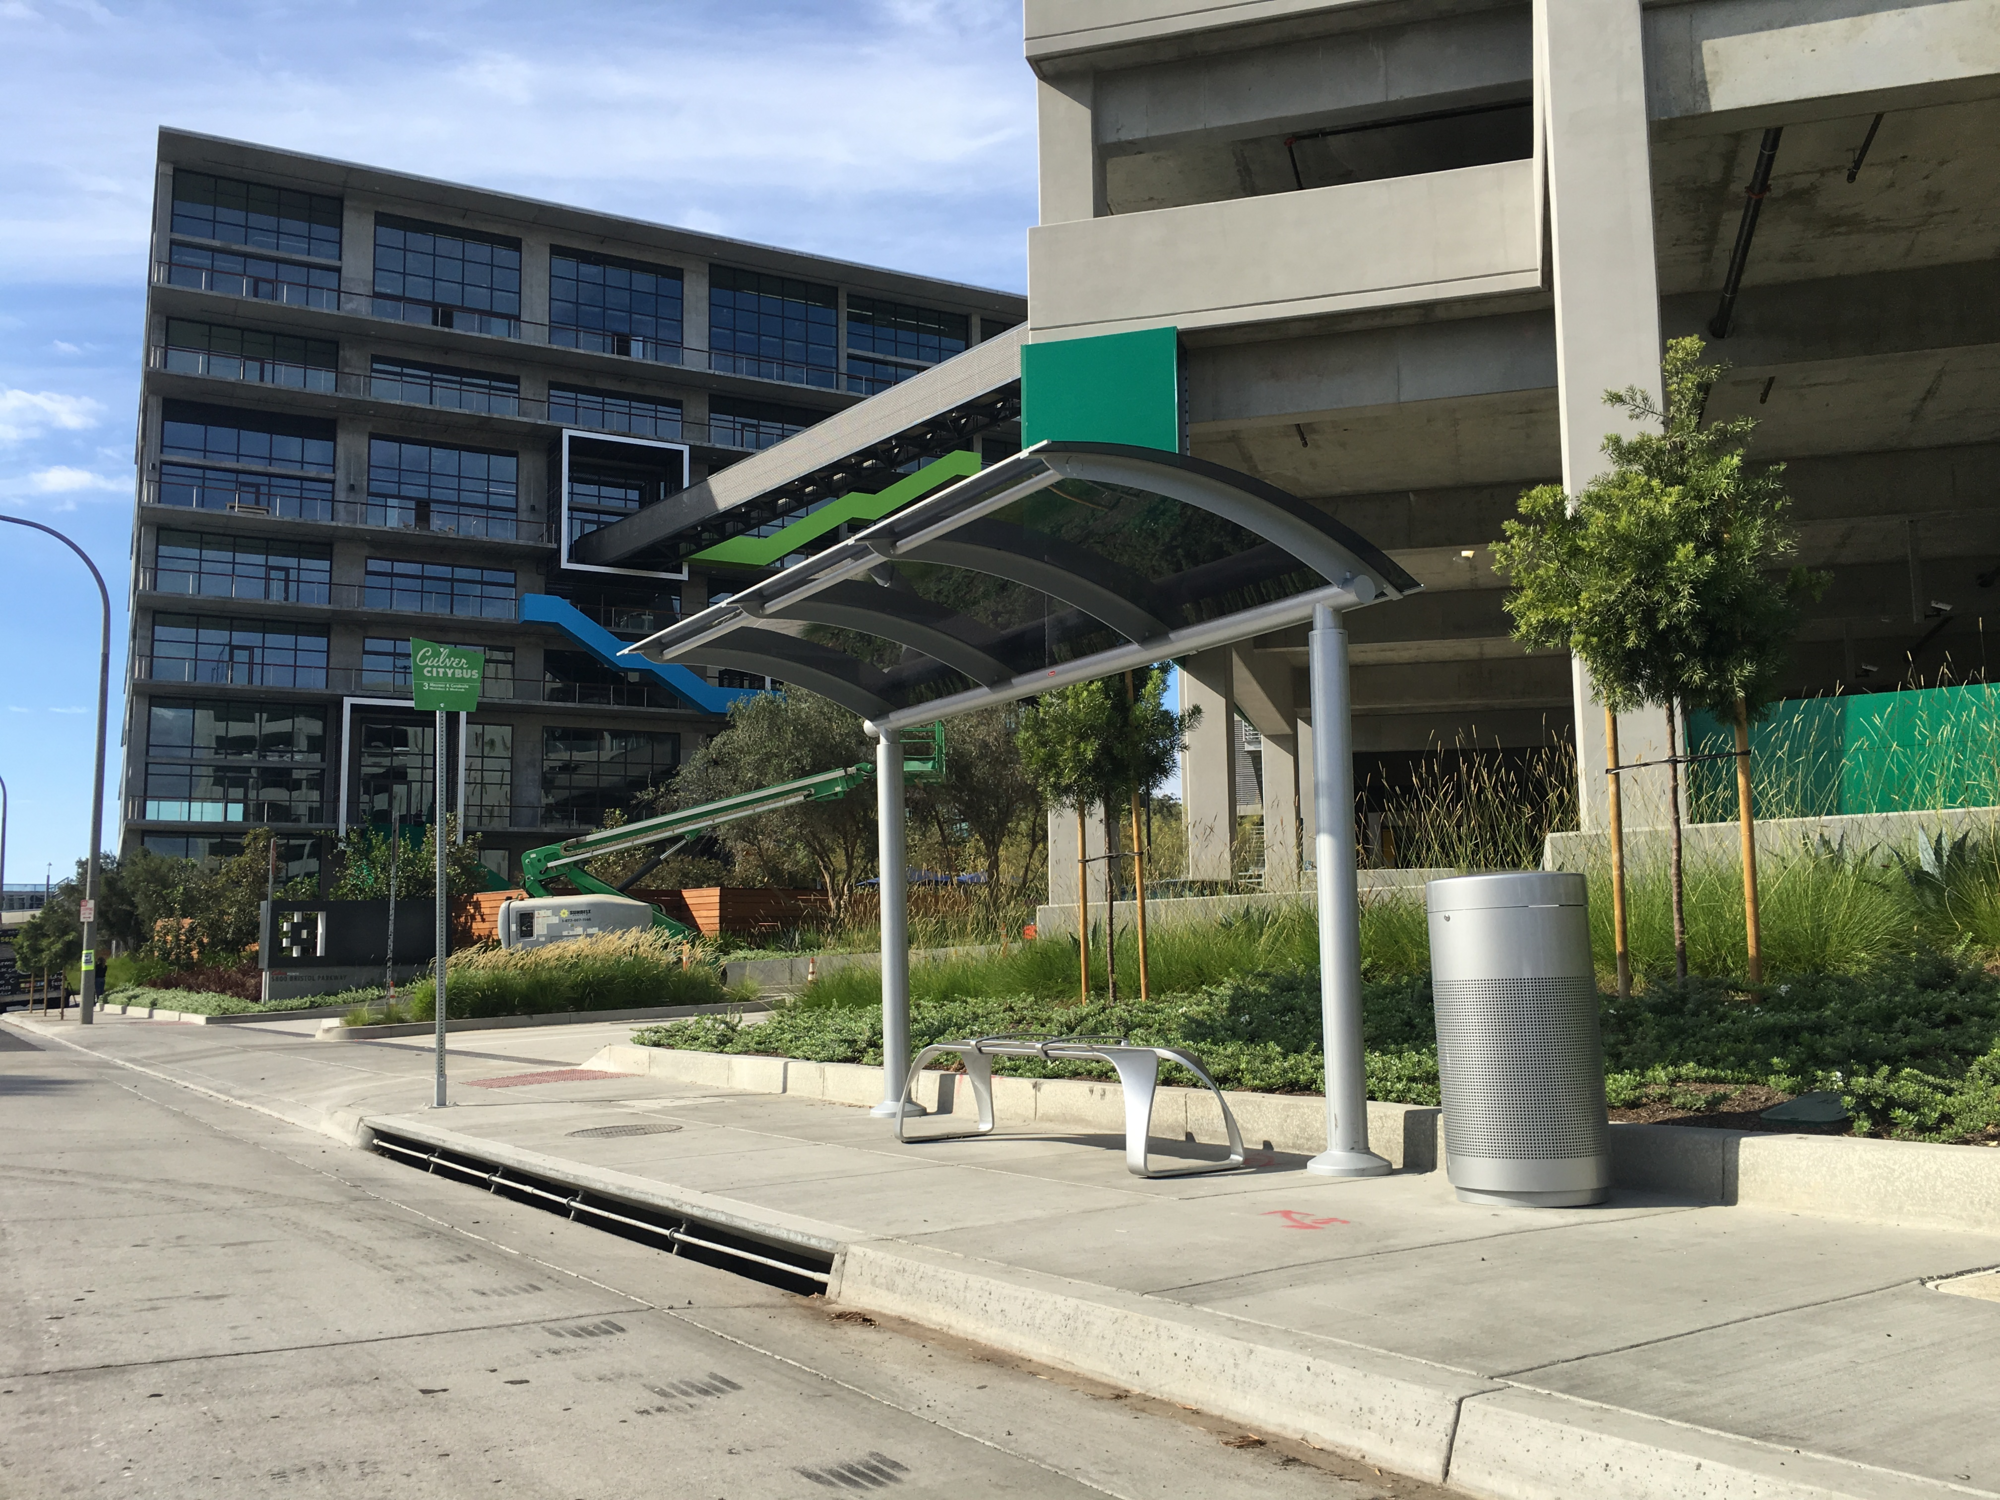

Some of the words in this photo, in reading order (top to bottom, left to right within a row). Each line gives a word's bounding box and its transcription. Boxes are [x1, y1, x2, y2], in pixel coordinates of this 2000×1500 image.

[416, 647, 468, 667] Culver
[424, 667, 479, 678] CITYBUS
[423, 682, 429, 690] 3
